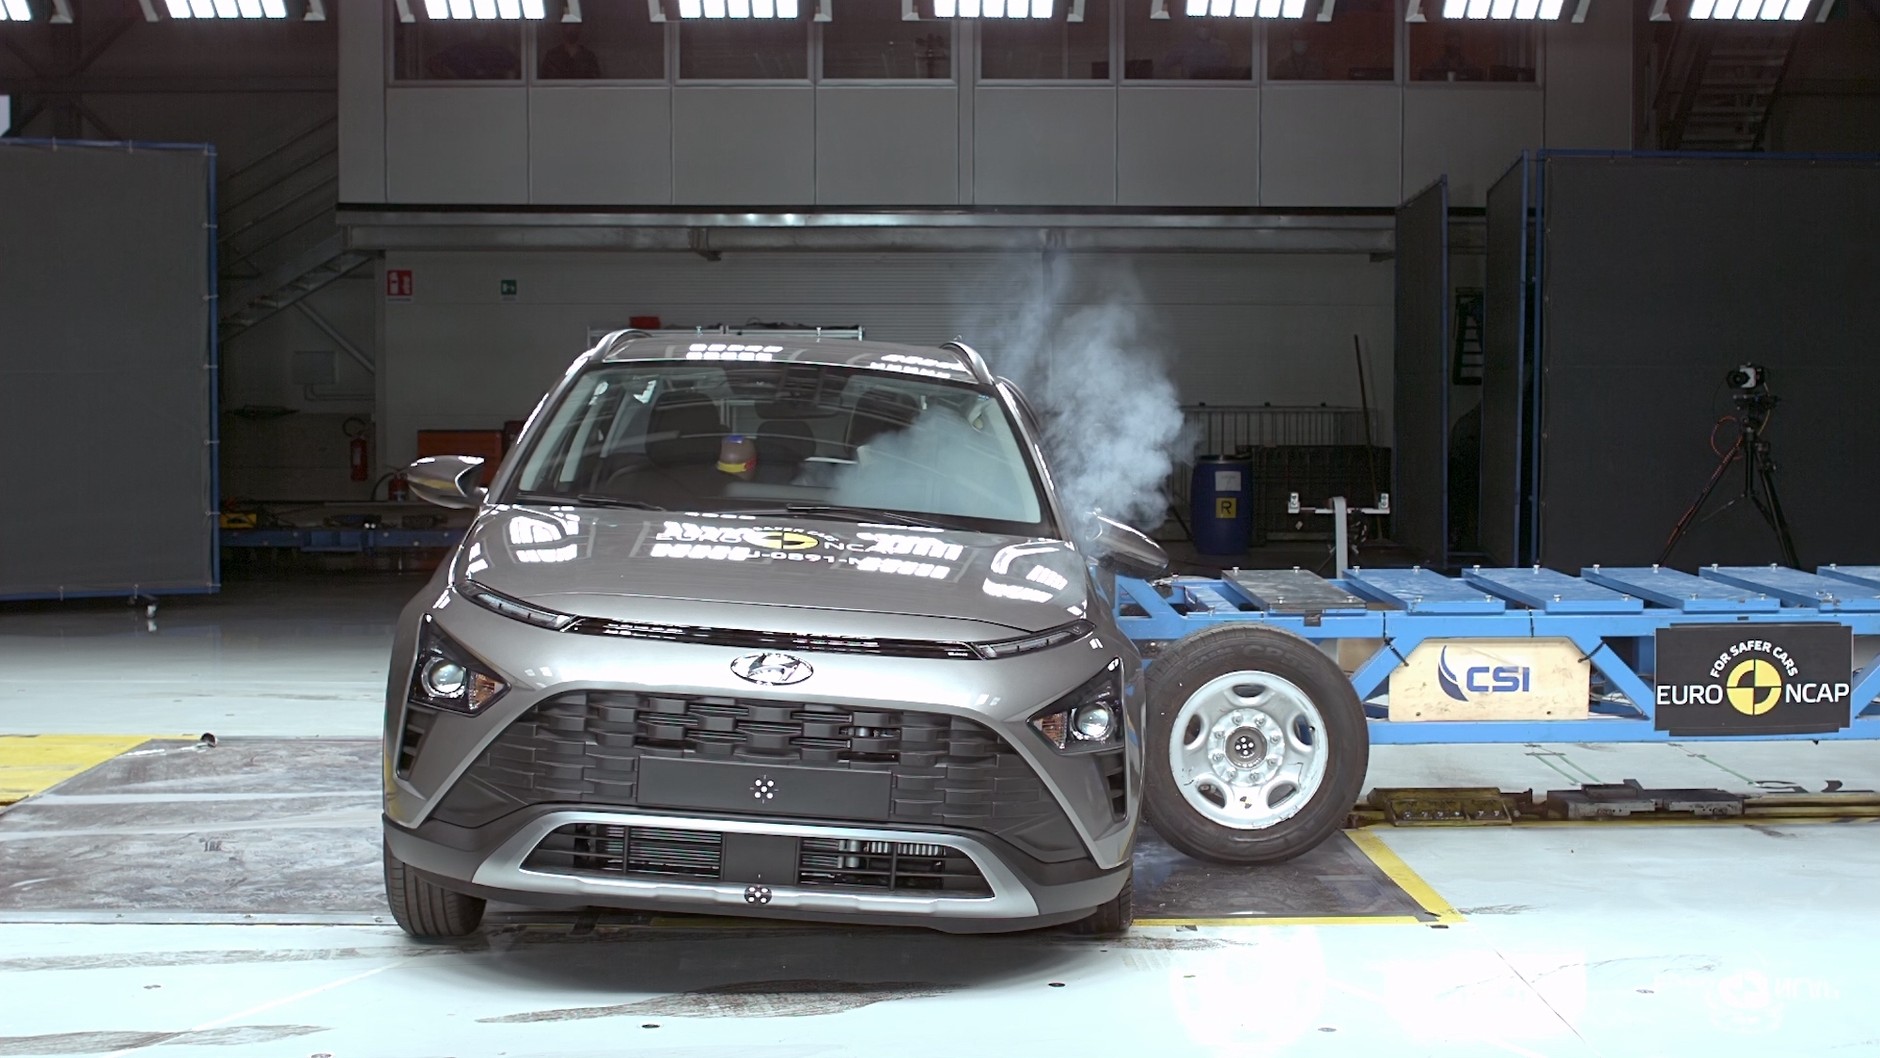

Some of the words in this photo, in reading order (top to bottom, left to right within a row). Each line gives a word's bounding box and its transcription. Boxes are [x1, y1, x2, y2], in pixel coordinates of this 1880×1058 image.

[1221, 500, 1232, 514] R
[1710, 652, 1731, 678] FOR
[1729, 640, 1771, 657] SAFER
[1772, 646, 1799, 677] CARS
[1466, 666, 1530, 692] CSI
[1656, 684, 1723, 705] EURO
[1785, 683, 1850, 704] NCAP
